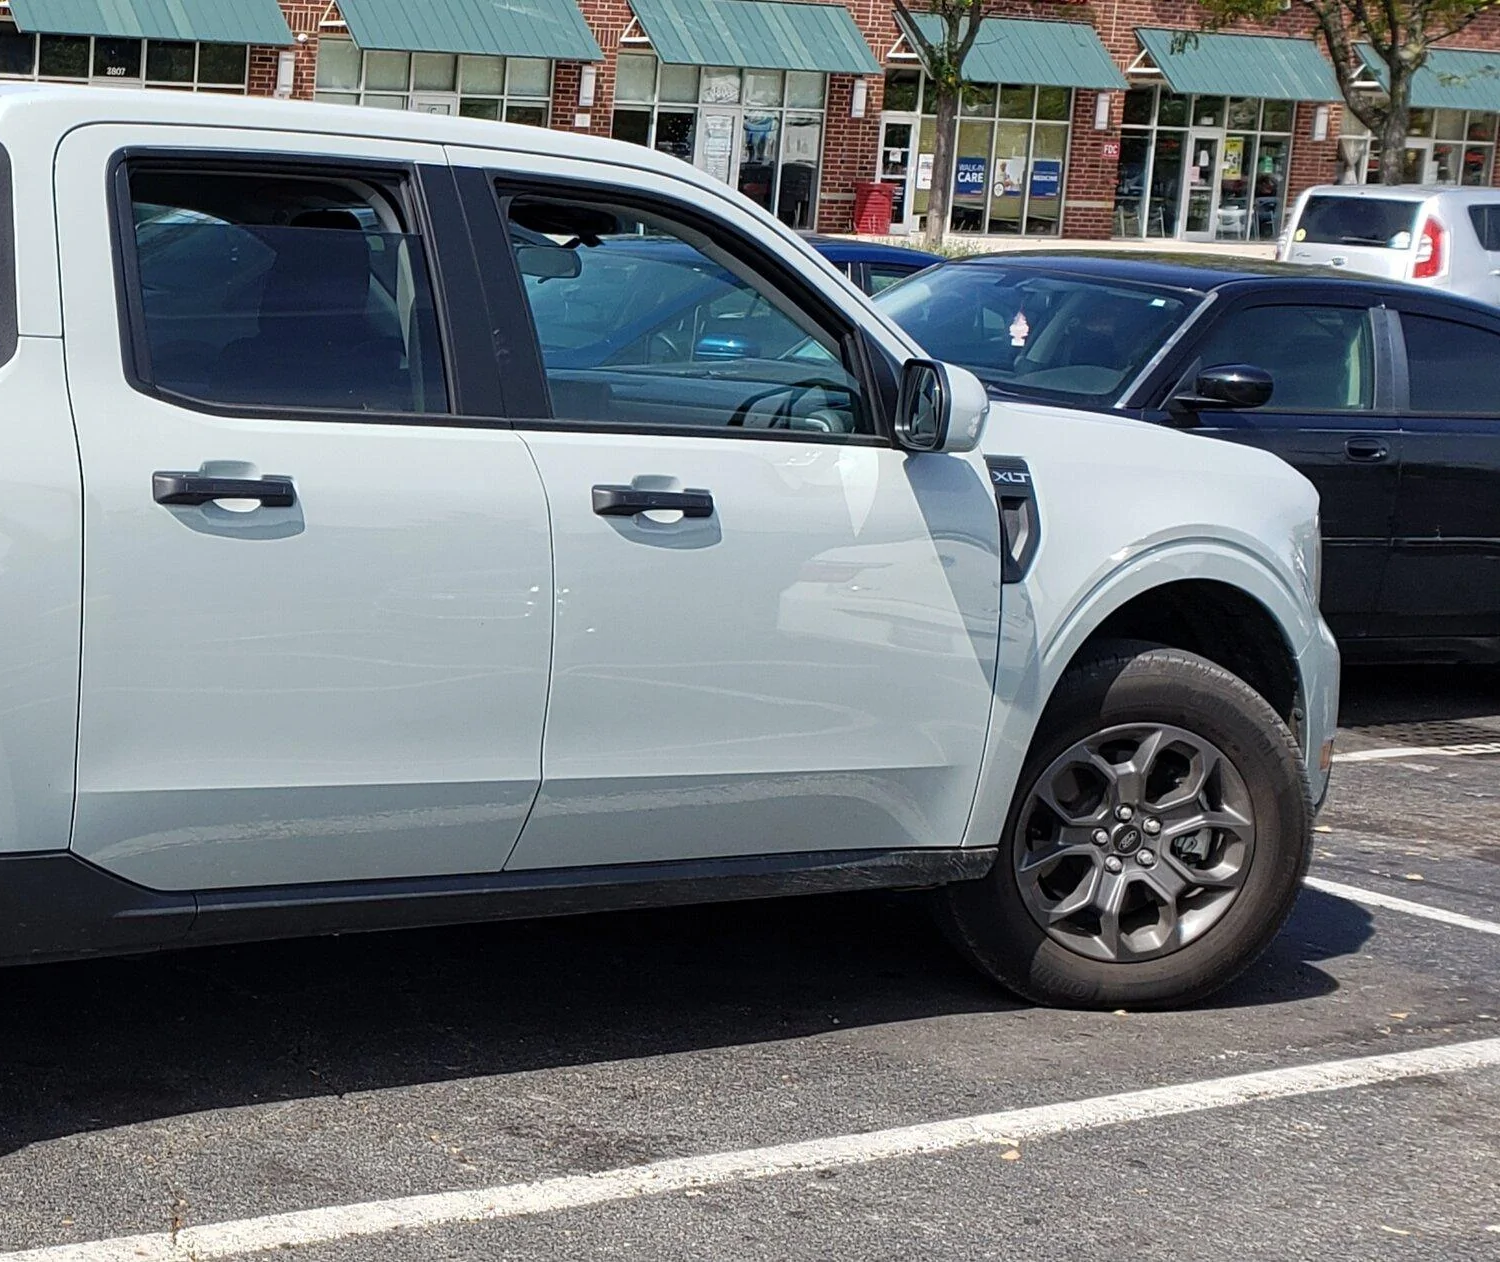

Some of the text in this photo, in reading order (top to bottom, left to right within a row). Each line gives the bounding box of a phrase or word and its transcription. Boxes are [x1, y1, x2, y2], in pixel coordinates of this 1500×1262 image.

[1104, 144, 1118, 154] FDC
[957, 172, 984, 182] CARE
[992, 470, 1030, 483] XLT
